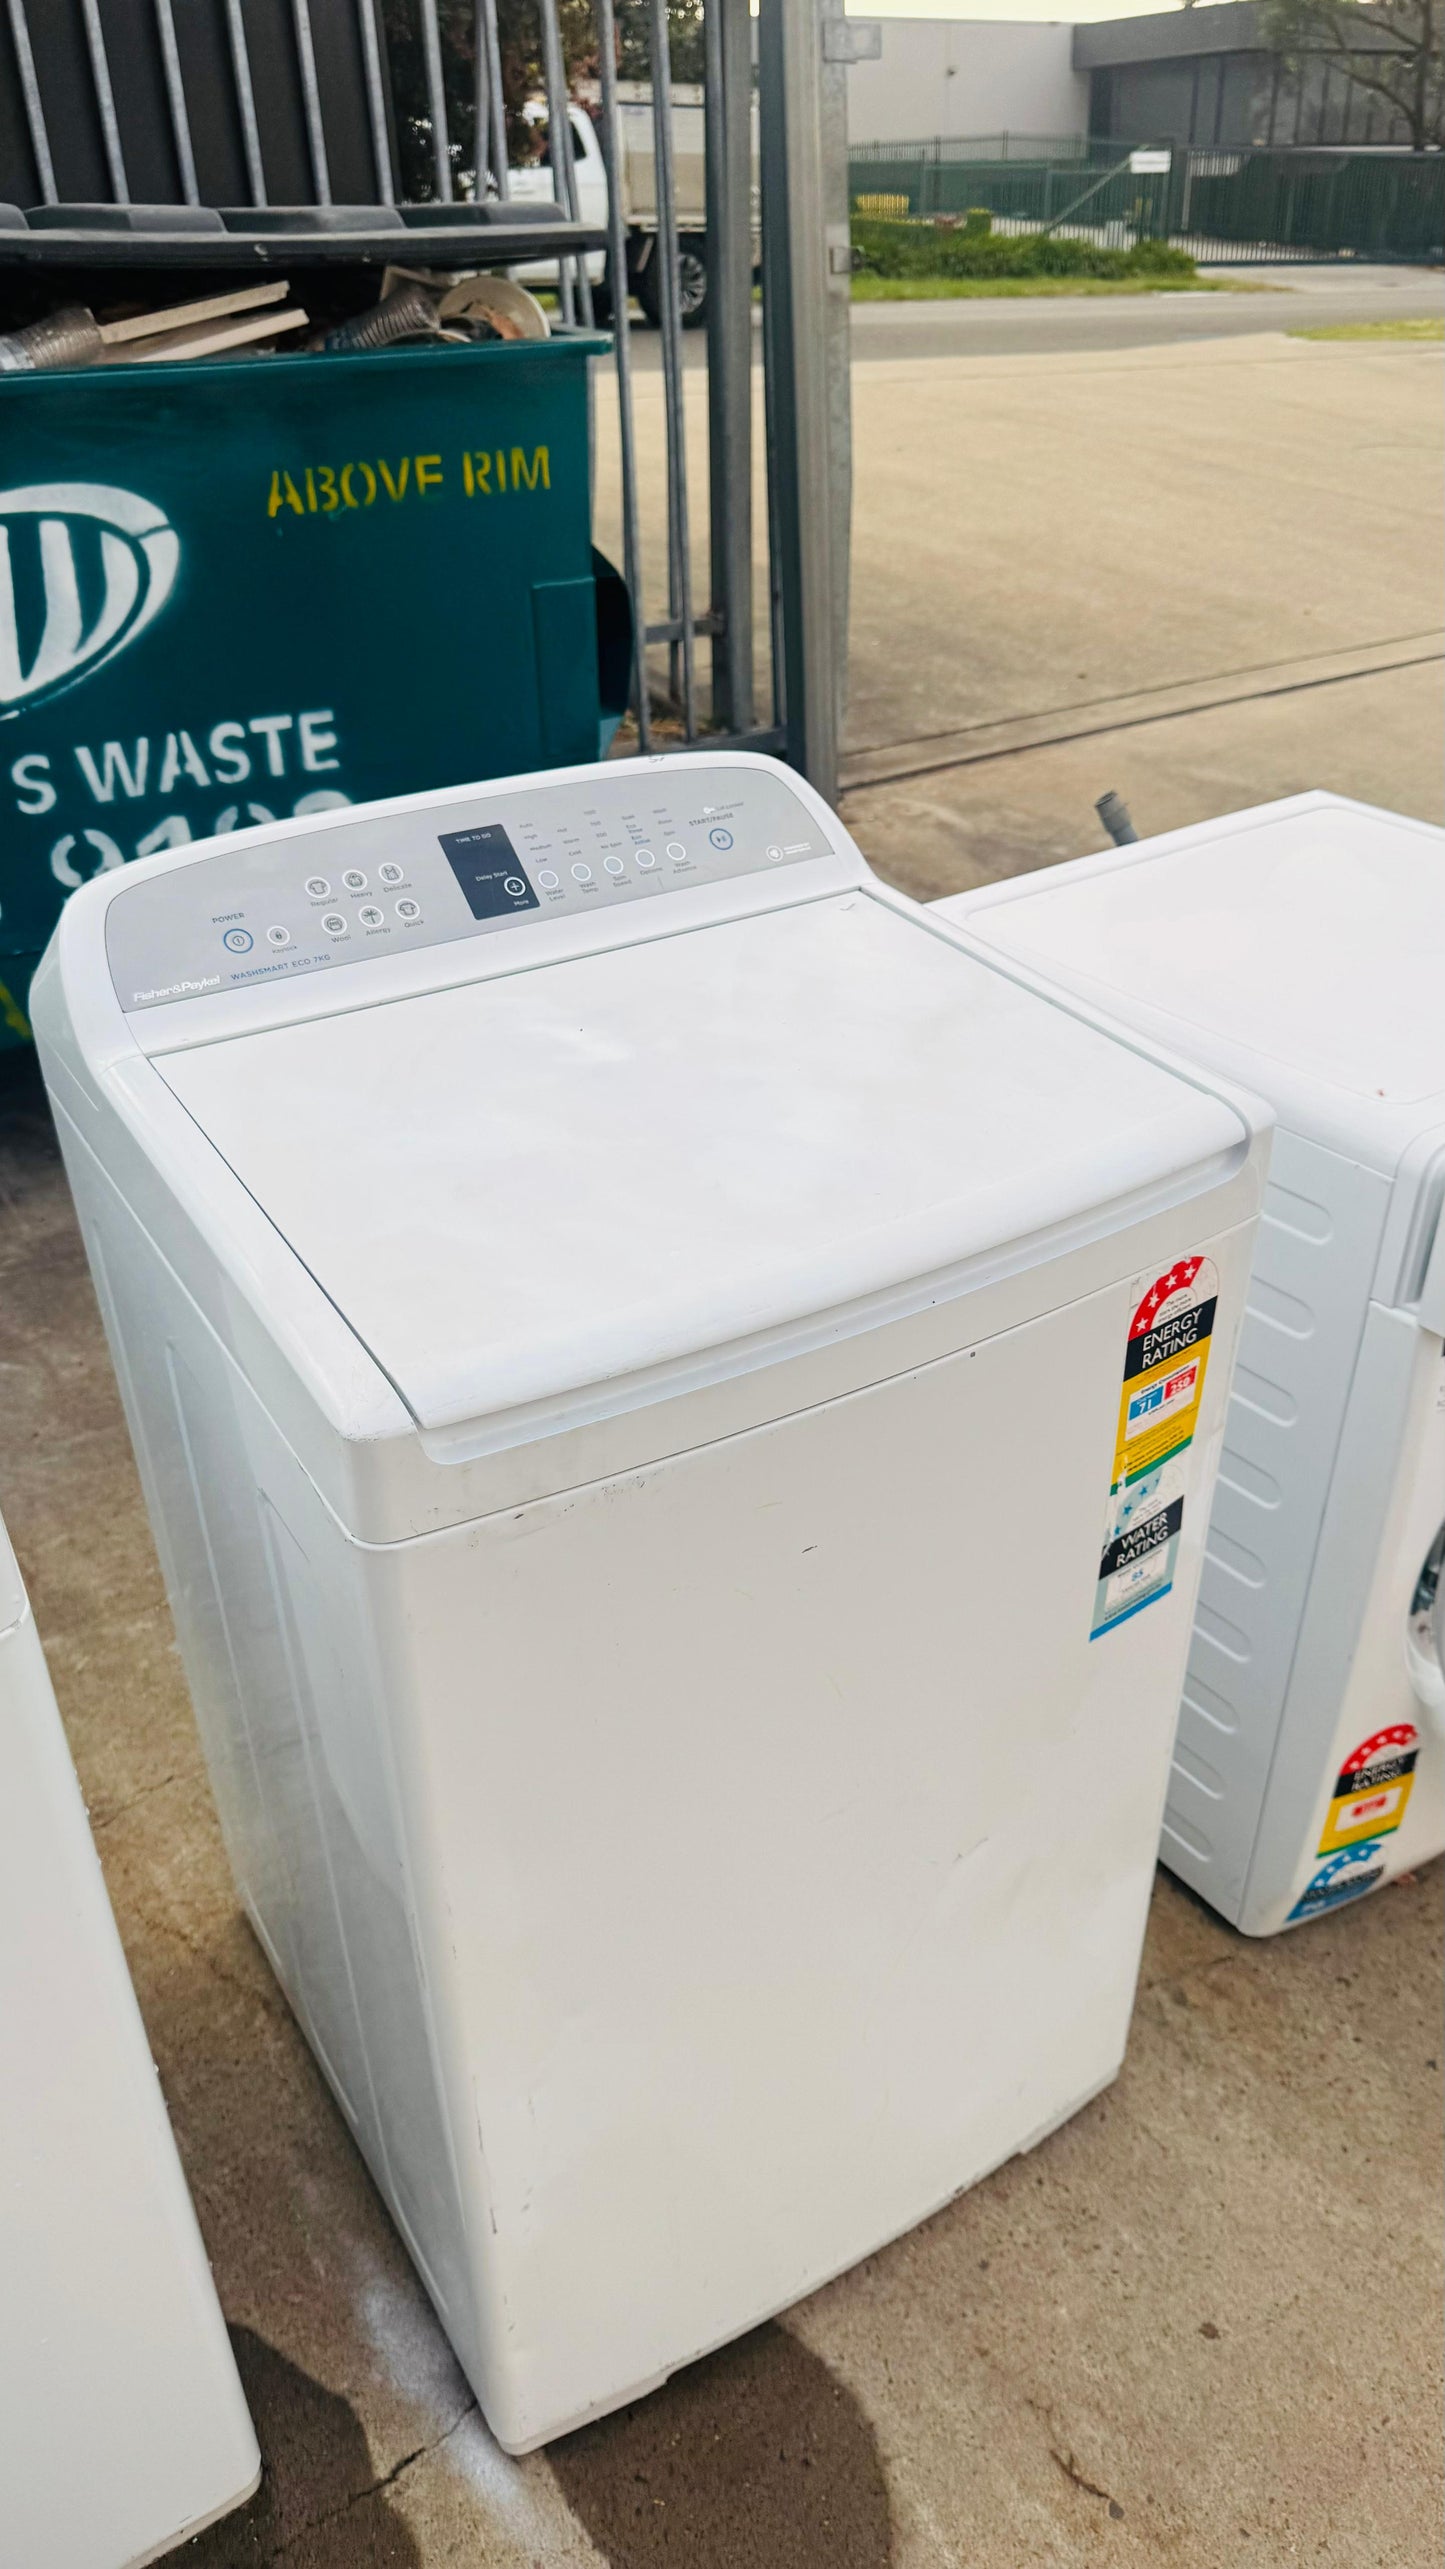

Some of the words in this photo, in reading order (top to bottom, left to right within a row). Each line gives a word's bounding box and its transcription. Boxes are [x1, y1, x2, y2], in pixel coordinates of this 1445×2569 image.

[267, 454, 444, 518] ABOVE
[463, 446, 551, 498] RIM
[74, 709, 341, 803] WASTE
[456, 836, 472, 845] TIME
[472, 834, 481, 842] TO
[475, 874, 493, 882] Delay
[493, 870, 508, 879] Start
[211, 912, 245, 925] POWER
[404, 919, 424, 929] Quick
[230, 962, 289, 981] WASHSMART
[292, 956, 311, 968] ECO
[313, 953, 332, 966] 7KG
[133, 975, 221, 1003] Fisher&Paykel
[1142, 1307, 1204, 1352] ENERGY
[1141, 1328, 1199, 1369] RATING
[1115, 1526, 1170, 1568] RATING
[1120, 1512, 1170, 1550] WATER
